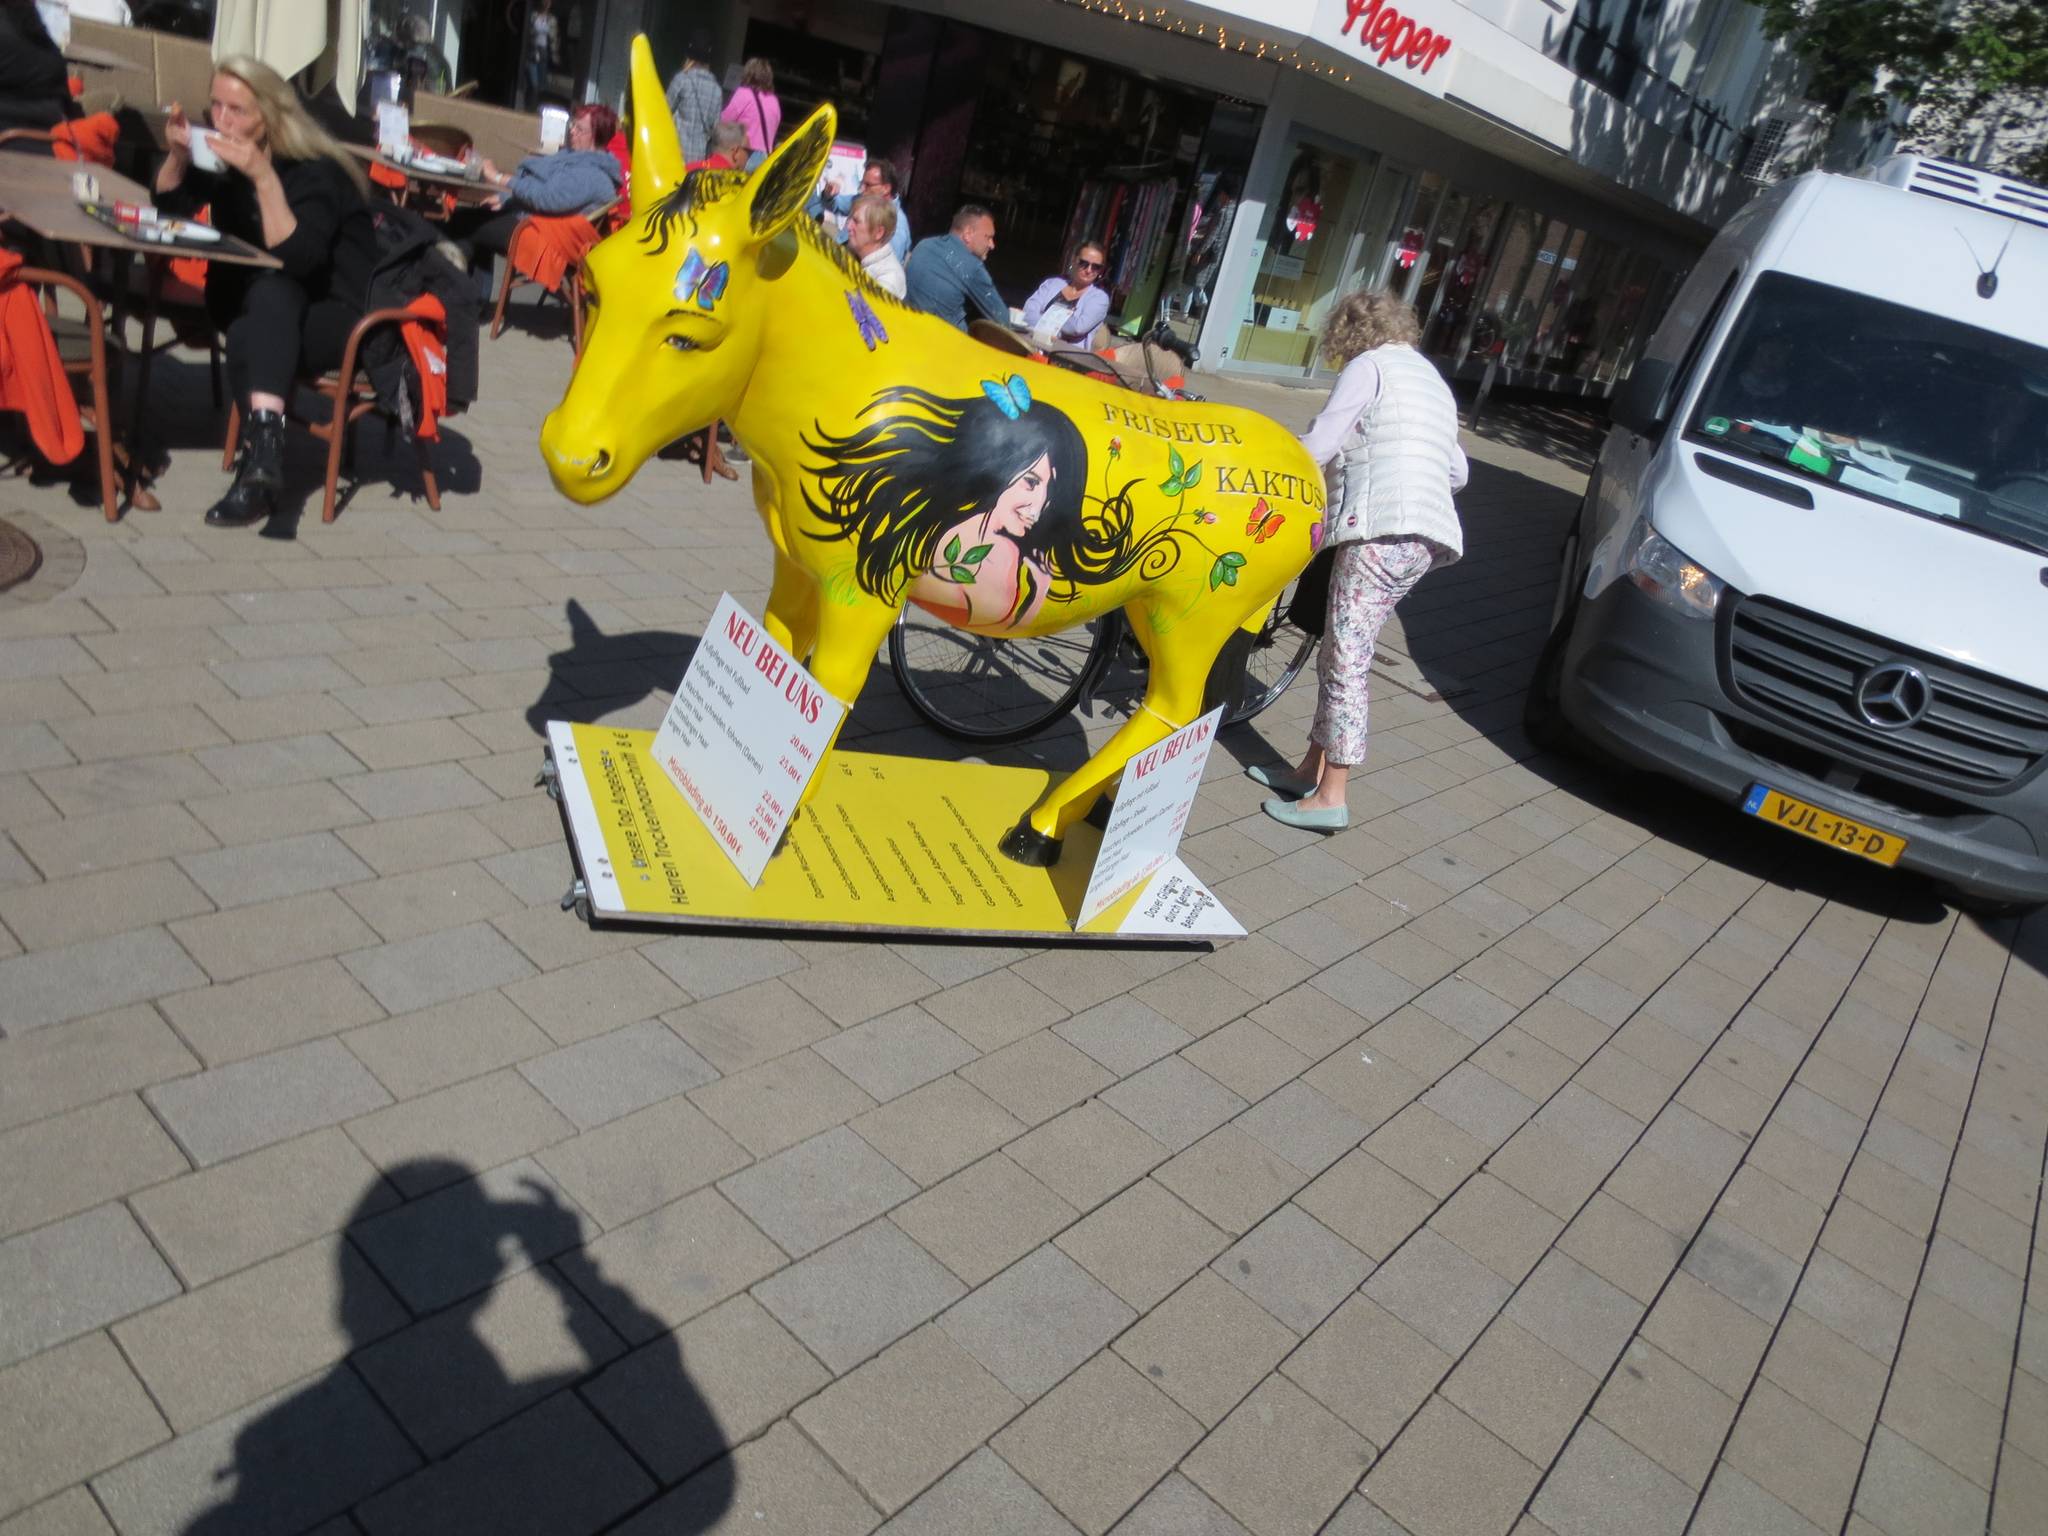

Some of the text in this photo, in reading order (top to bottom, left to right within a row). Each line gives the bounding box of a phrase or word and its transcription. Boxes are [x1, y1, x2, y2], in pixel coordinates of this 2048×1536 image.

[1103, 403, 1242, 445] FRISEUR
[1215, 466, 1324, 511] KAKTUS
[722, 609, 826, 727] NEU BEI UNS
[723, 662, 734, 678] mit
[1160, 731, 1187, 765] BEI
[620, 752, 672, 858] Trockenhaarschnitt
[666, 754, 706, 810] Microblading
[702, 801, 714, 819] ab
[617, 808, 633, 828] Top
[1777, 799, 1885, 855] VJL-13-D
[662, 861, 690, 905] Herren
